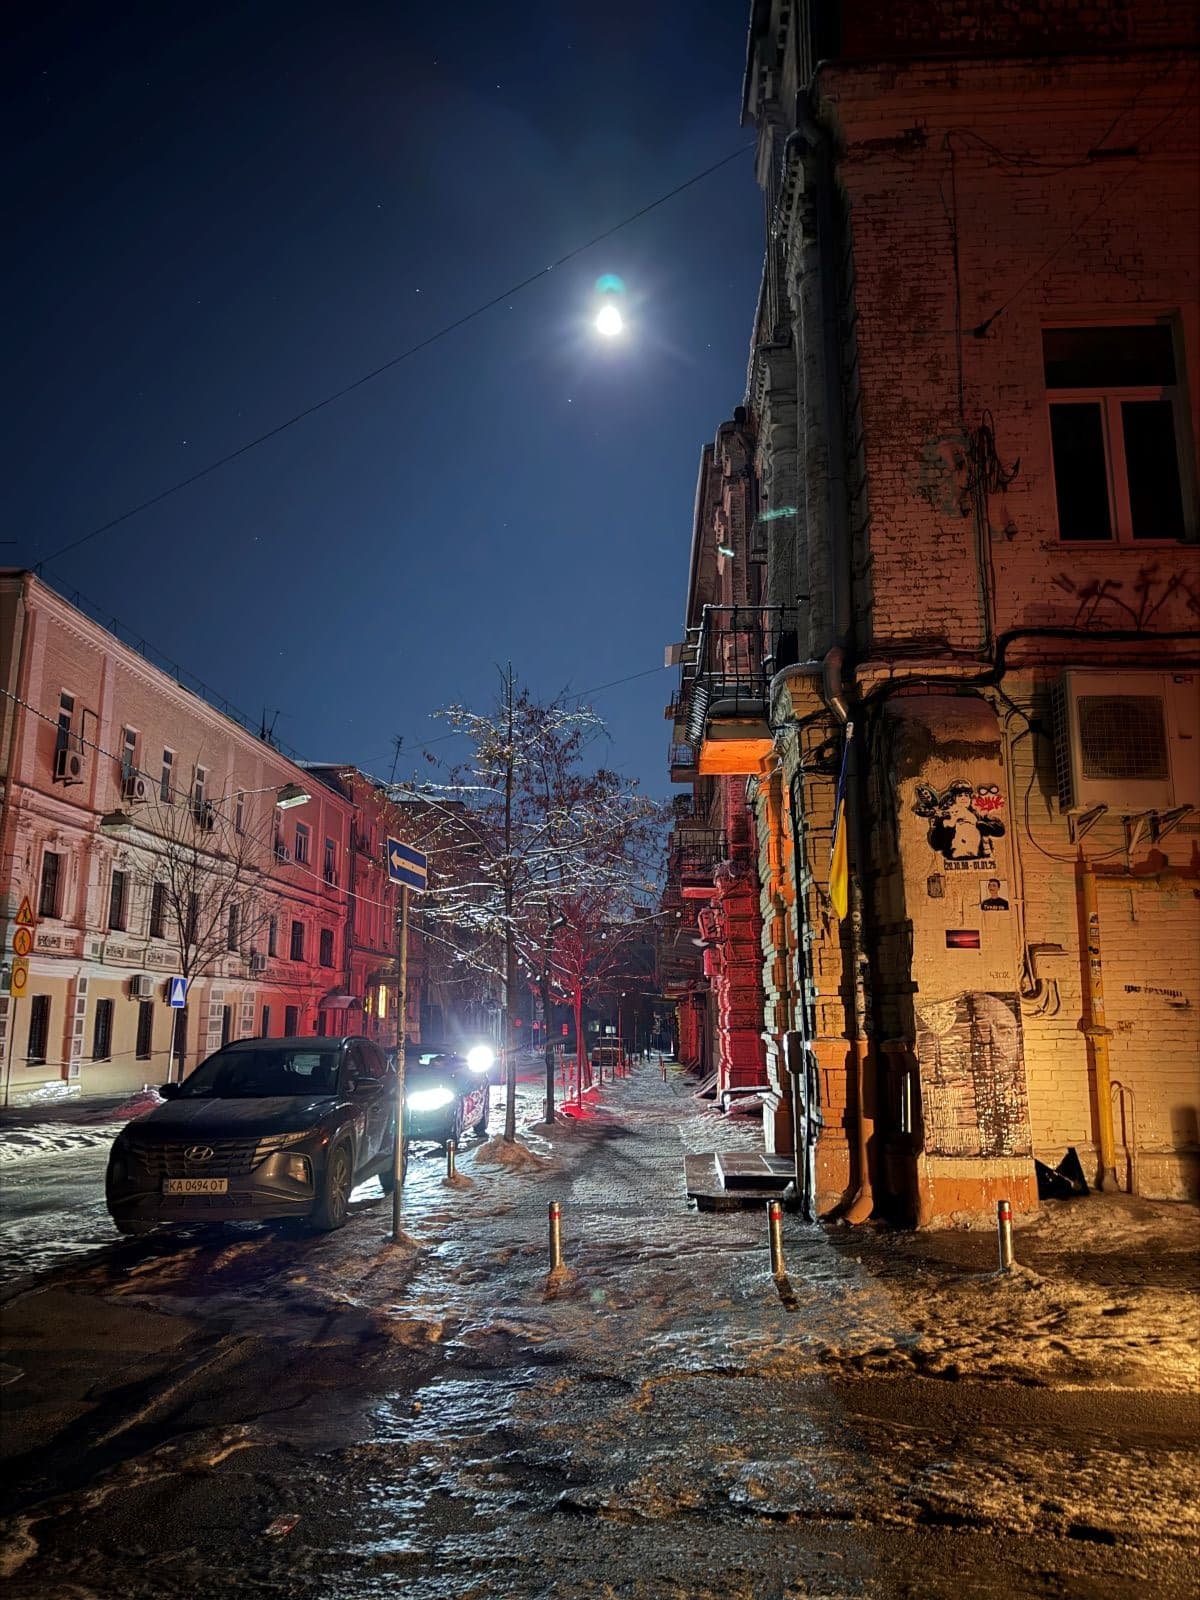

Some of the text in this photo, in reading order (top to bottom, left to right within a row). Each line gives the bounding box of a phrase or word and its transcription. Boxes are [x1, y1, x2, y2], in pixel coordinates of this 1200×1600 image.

[169, 1180, 225, 1191] KA 0494 OT
